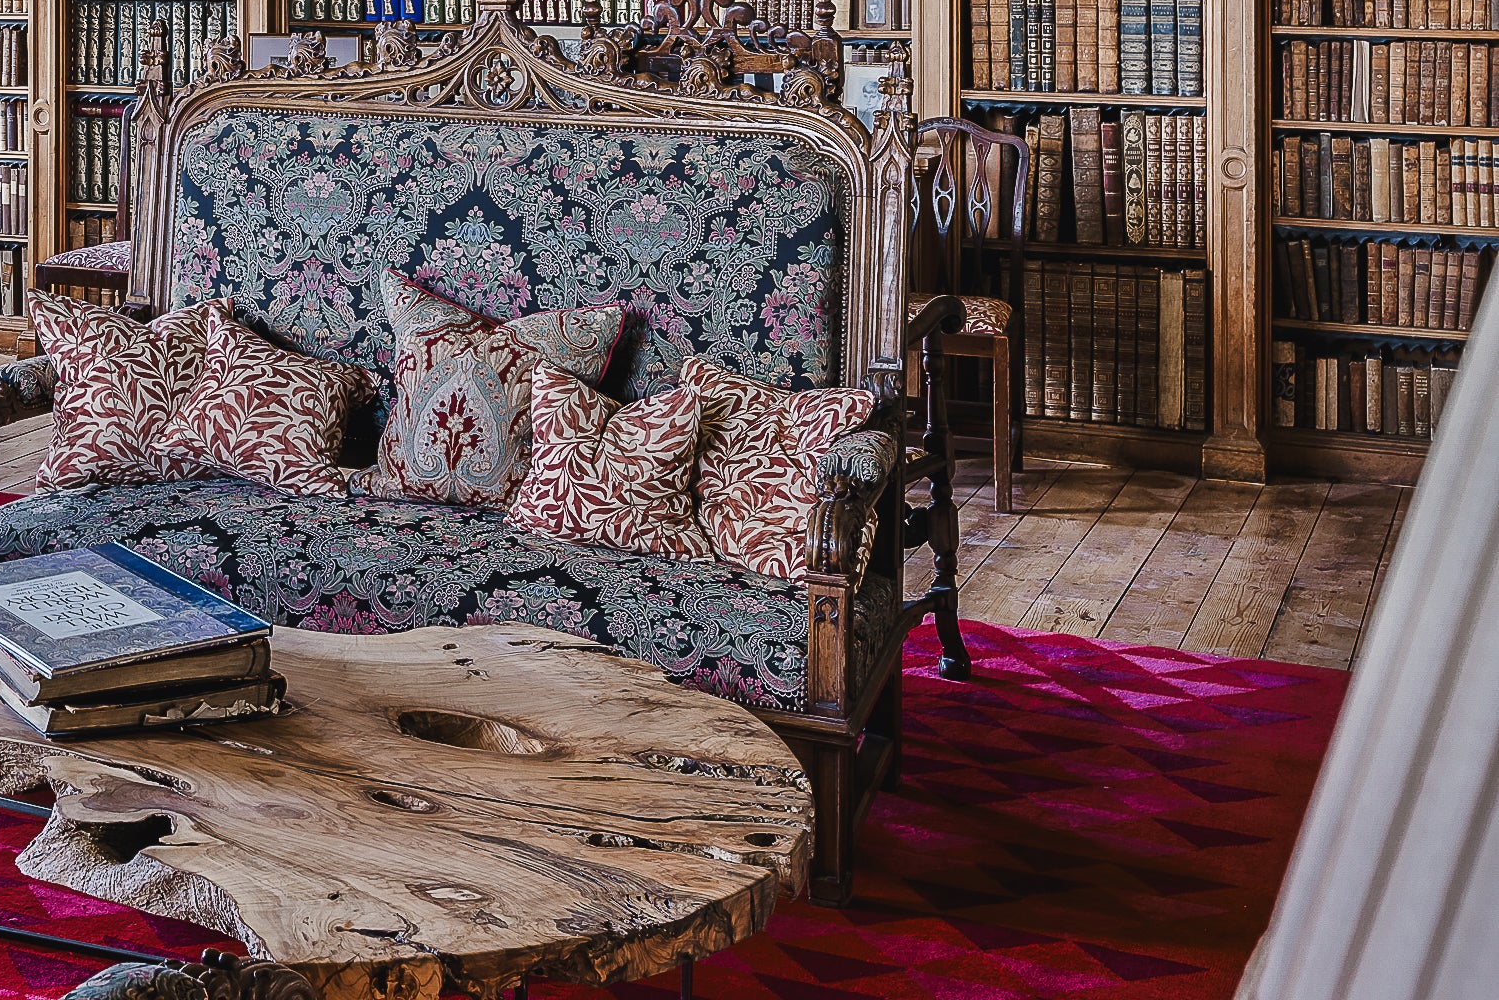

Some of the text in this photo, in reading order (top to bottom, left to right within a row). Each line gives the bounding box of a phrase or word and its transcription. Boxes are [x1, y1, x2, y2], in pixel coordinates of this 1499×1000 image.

[6, 582, 104, 608] HISTORY
[18, 591, 111, 612] WORLD
[43, 601, 126, 624] CHART
[62, 603, 85, 611] OF
[57, 611, 130, 628] WALL
[84, 620, 125, 631] THE
